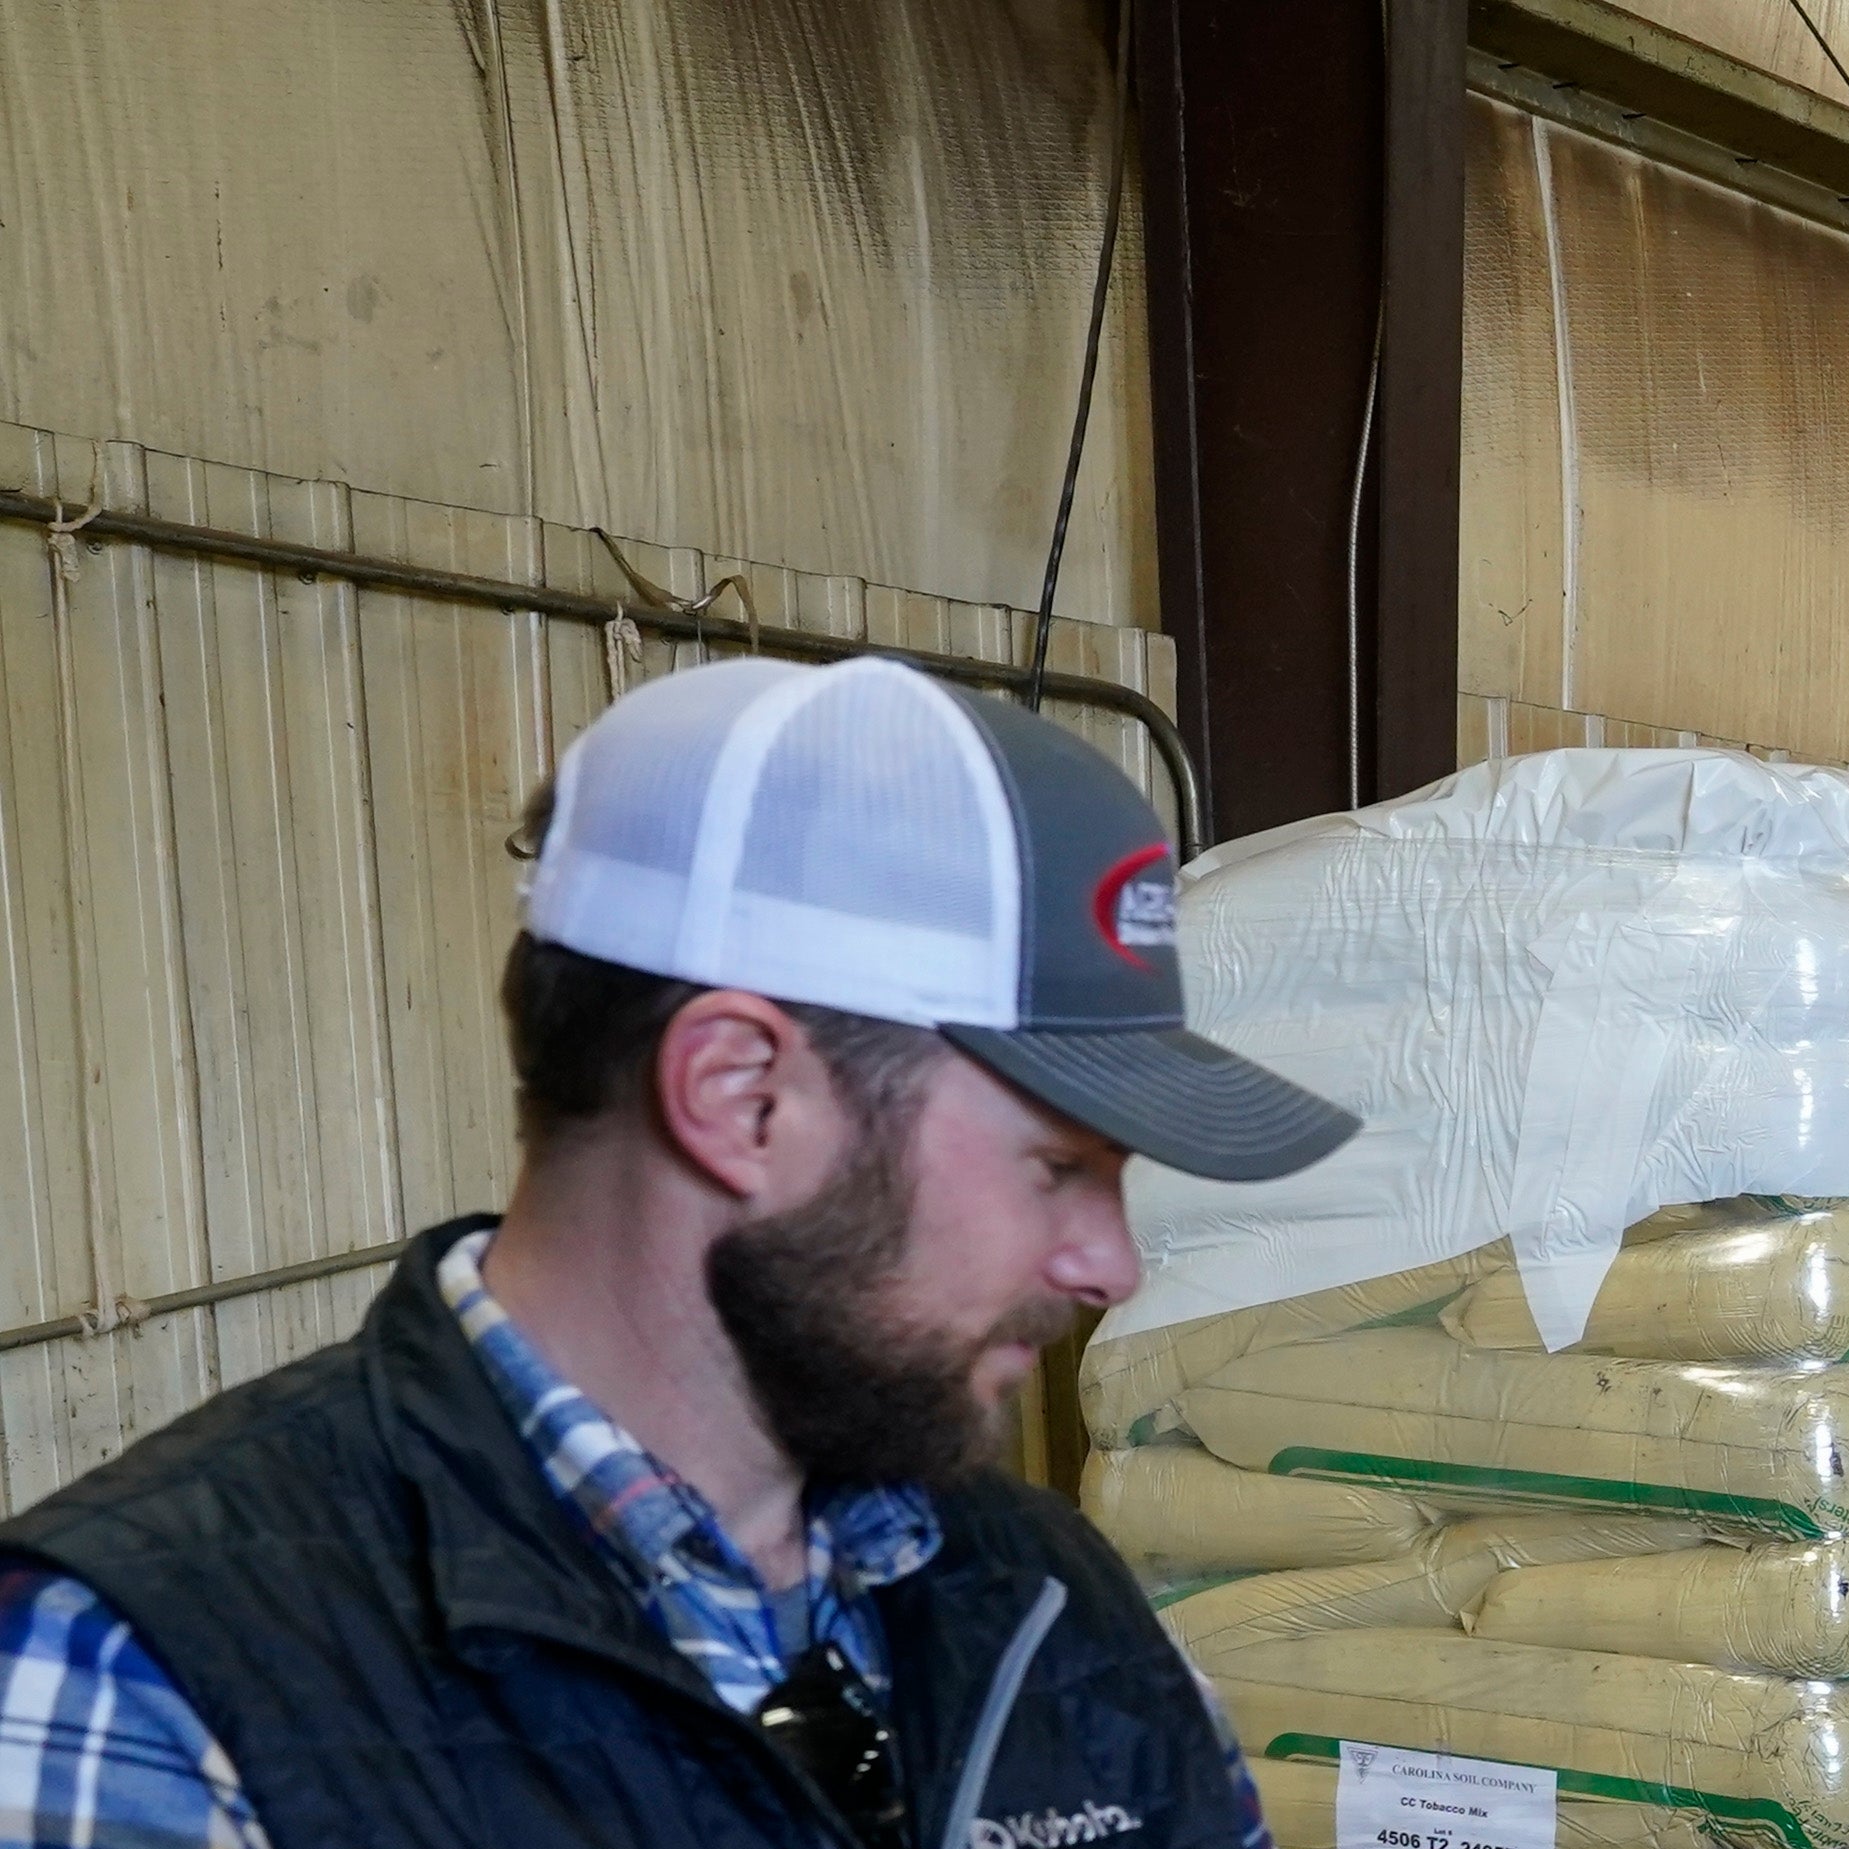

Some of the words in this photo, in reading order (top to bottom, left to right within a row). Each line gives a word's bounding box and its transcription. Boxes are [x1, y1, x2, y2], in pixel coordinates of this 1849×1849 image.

[1392, 1763, 1451, 1782] CAROLINA
[1452, 1773, 1481, 1786] SOIL
[1481, 1776, 1537, 1794] COMPANY
[1400, 1796, 1416, 1807] CC
[1419, 1799, 1466, 1815] Tobacco
[1468, 1806, 1489, 1818] Mix
[1377, 1829, 1421, 1849] 4506
